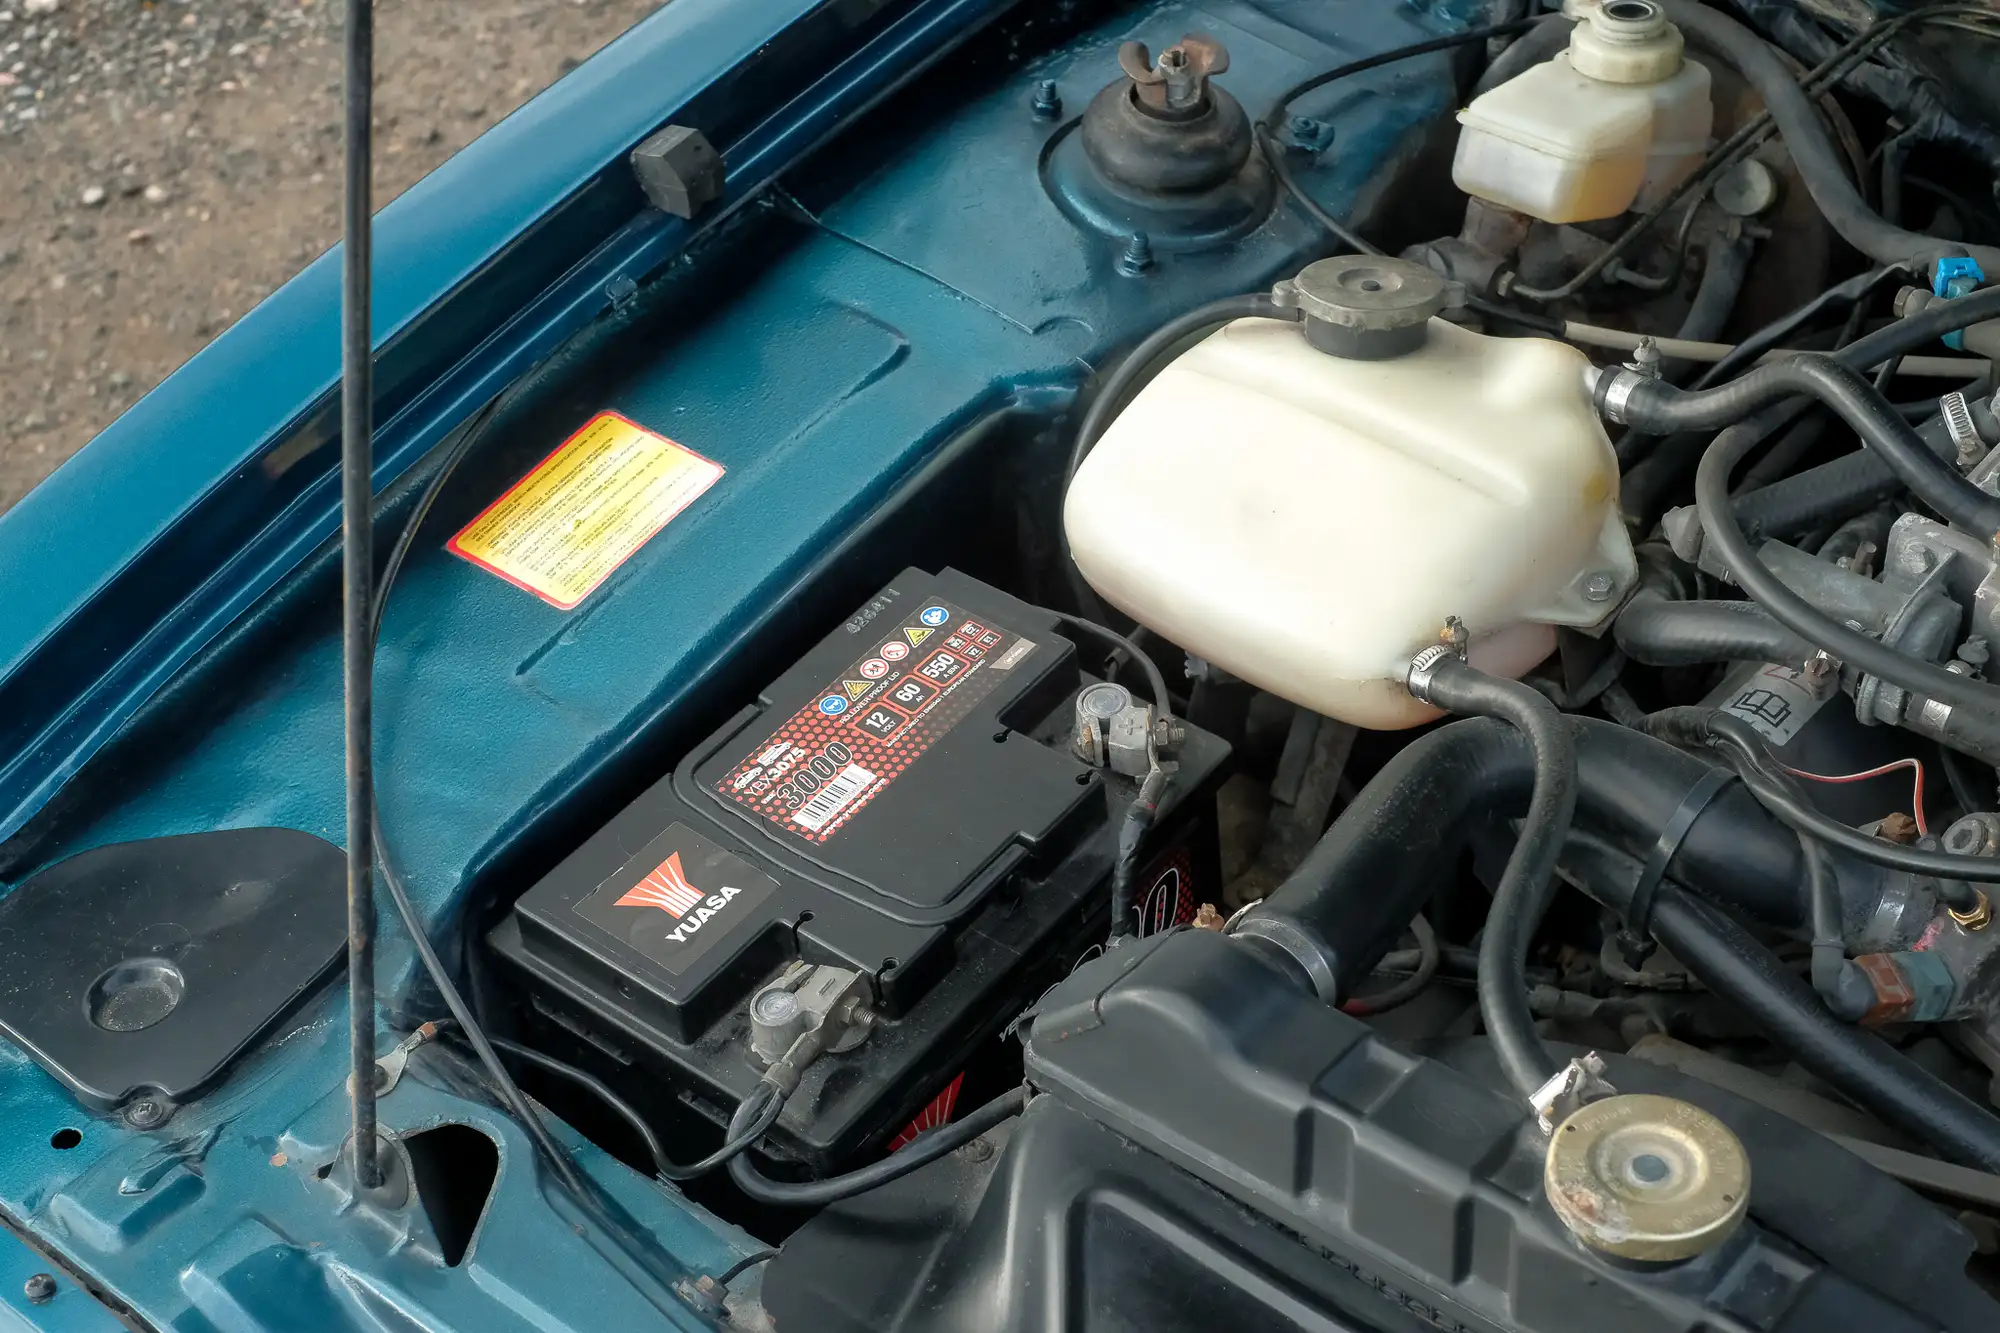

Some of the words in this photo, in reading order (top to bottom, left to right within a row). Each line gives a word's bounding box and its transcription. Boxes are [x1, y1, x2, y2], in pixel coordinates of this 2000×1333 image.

[922, 653, 955, 679] 550
[838, 696, 872, 724] ROLLOVER
[867, 678, 892, 698] PROOF
[886, 670, 901, 681] LID
[895, 683, 921, 702] 60
[865, 711, 890, 729] 12
[880, 719, 897, 733] VOLT
[744, 747, 805, 797] YBX3075
[777, 741, 853, 810] 3000
[665, 886, 742, 943] YUASA
